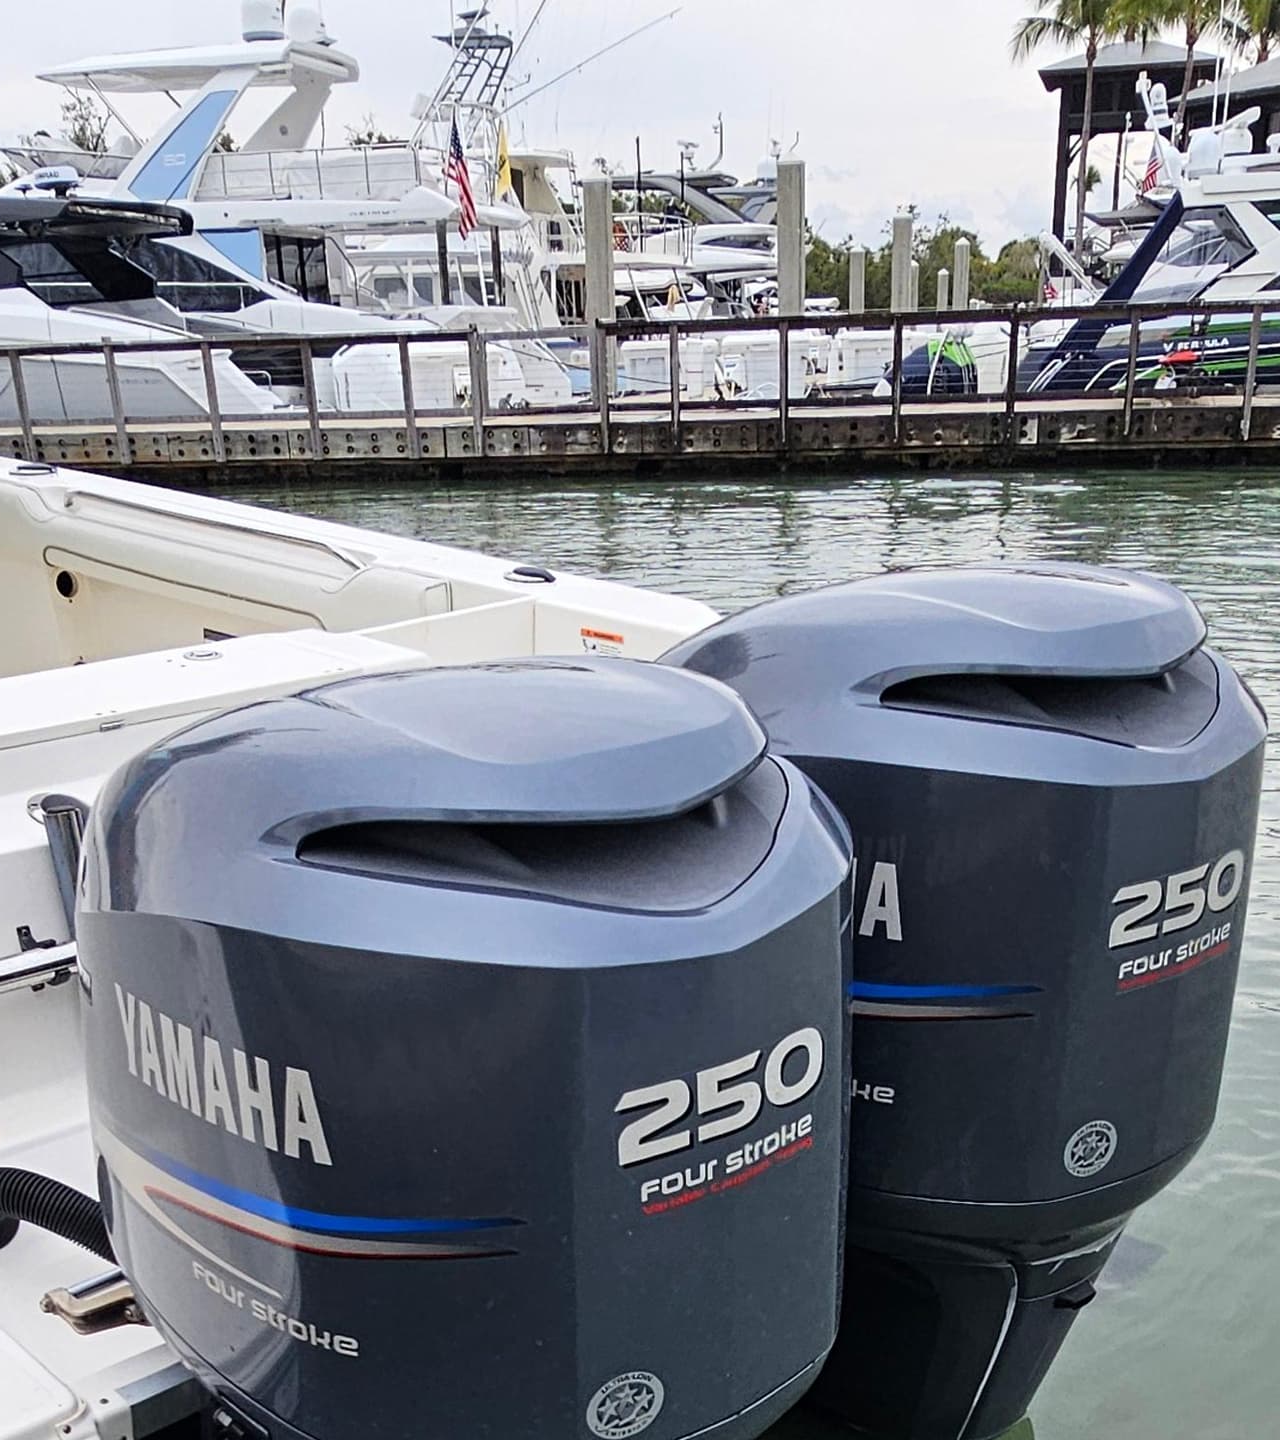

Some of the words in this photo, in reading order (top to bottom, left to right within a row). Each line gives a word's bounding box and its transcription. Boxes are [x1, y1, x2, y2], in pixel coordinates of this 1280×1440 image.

[1108, 849, 1245, 949] 250
[113, 981, 333, 1167] YAMAHA
[614, 1027, 825, 1169] 250
